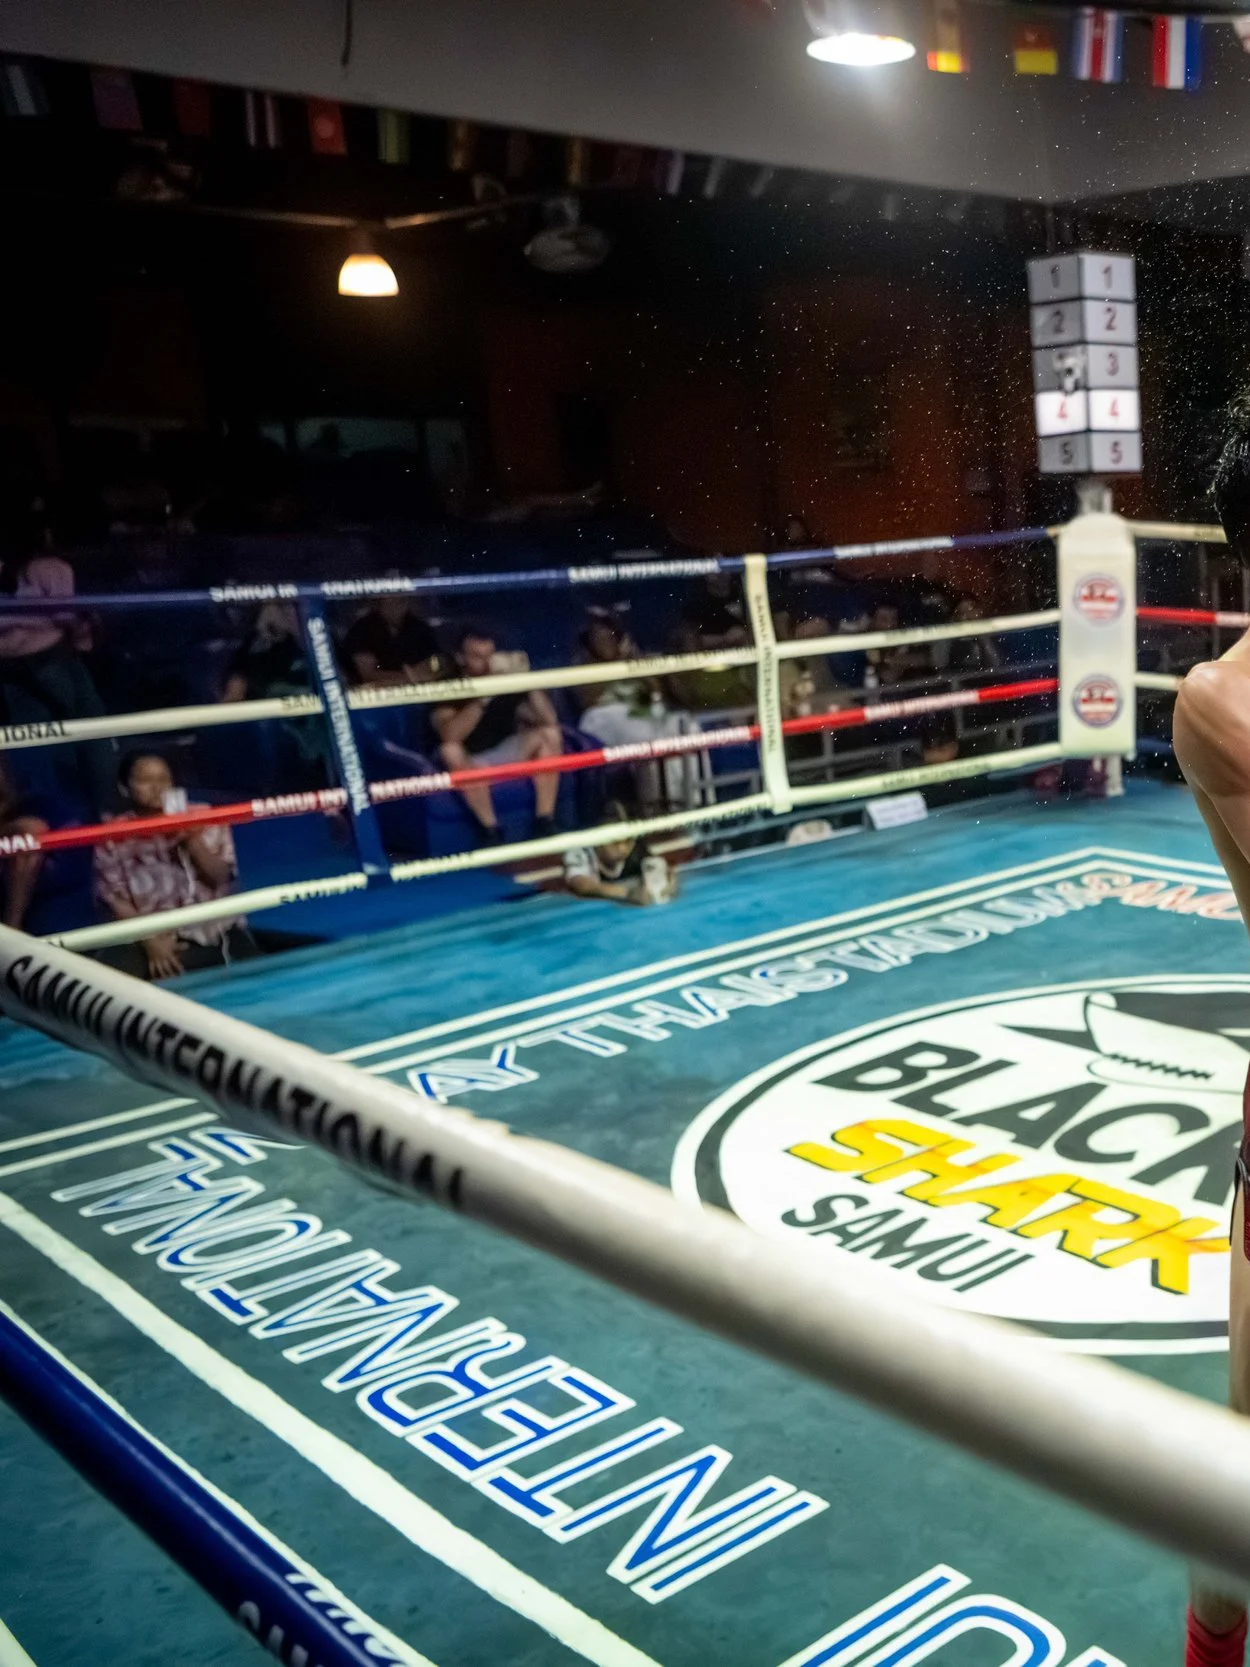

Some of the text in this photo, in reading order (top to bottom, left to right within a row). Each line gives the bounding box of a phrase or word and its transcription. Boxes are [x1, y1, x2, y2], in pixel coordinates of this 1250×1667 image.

[1051, 264, 1062, 289] 1
[1102, 264, 1114, 289] 1
[1052, 309, 1066, 334] 2
[1104, 306, 1117, 331] 2
[1106, 352, 1120, 377] 3
[1108, 398, 1120, 418] 4
[1060, 441, 1074, 466] 5
[1110, 440, 1123, 465] 5
[782, 1118, 1231, 1296] SHARK
[780, 1193, 1036, 1294] SAMUI
